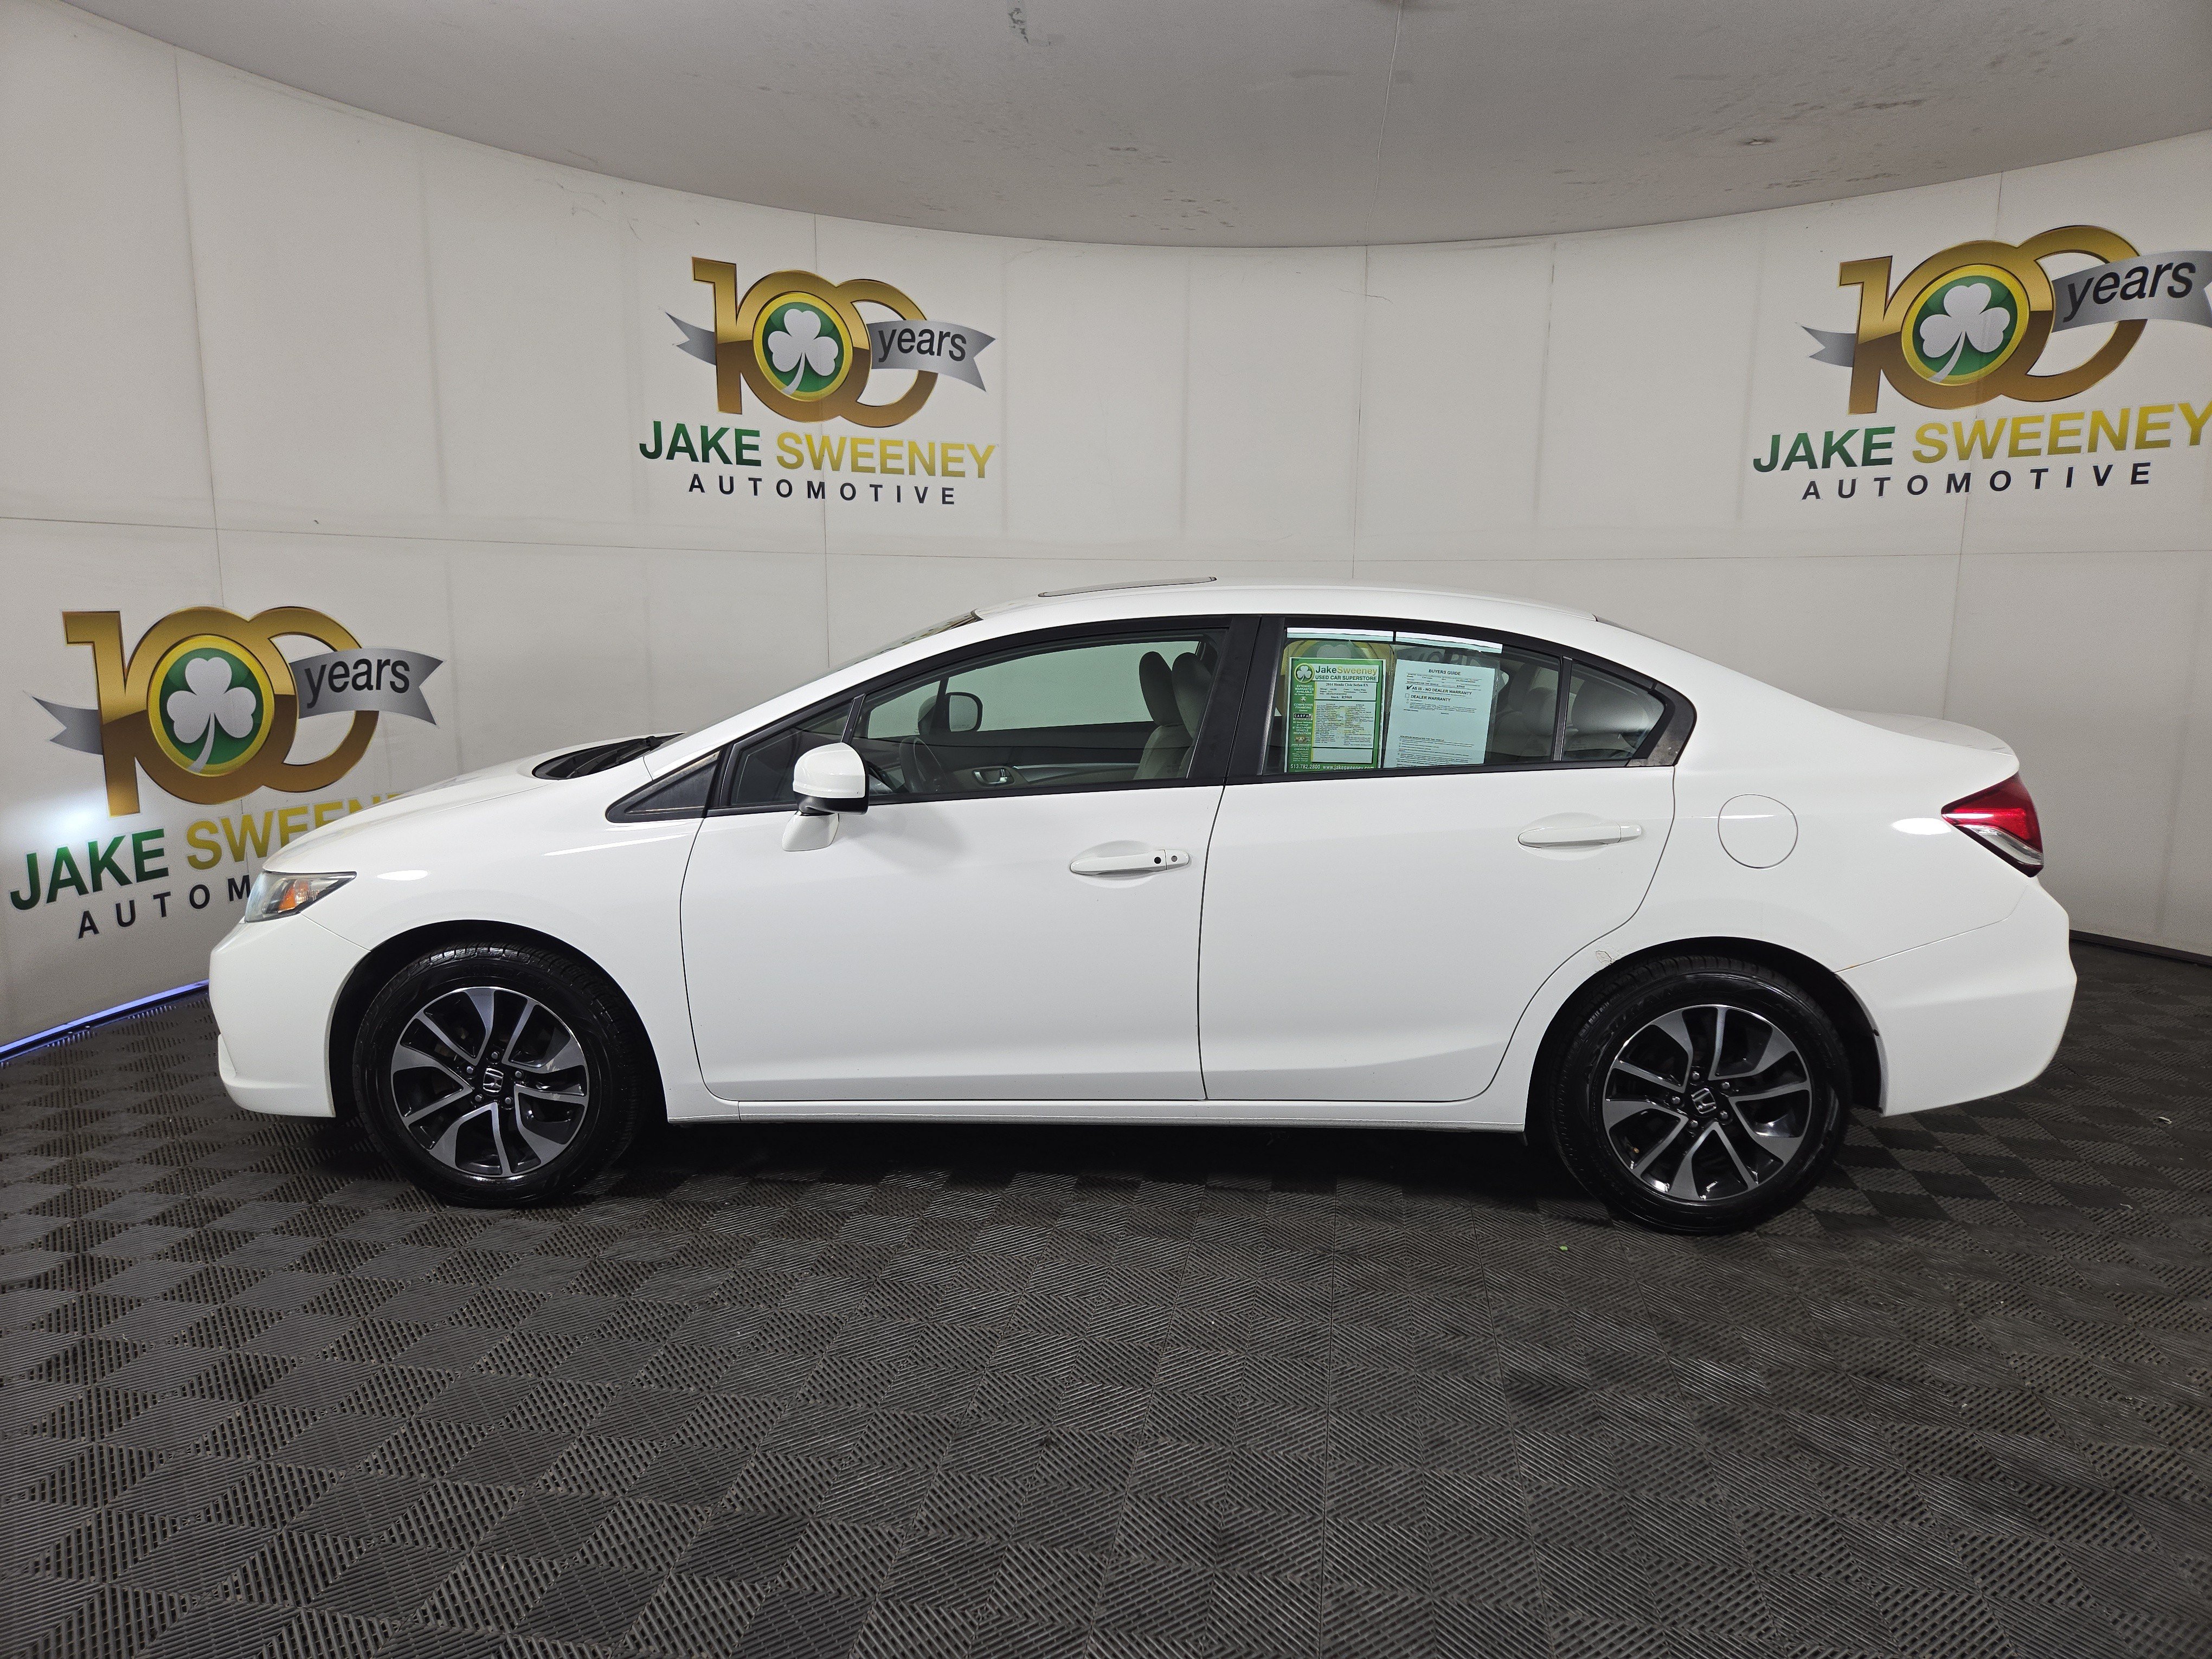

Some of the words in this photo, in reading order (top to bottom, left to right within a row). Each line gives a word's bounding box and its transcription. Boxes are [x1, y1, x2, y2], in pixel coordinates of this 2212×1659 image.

[2063, 261, 2196, 321] years
[878, 327, 967, 362] years
[639, 420, 762, 467] JAKE
[776, 430, 996, 478] SWEENEY
[1753, 426, 1896, 473] JAKE
[1912, 401, 2212, 464] SWEENEY
[689, 473, 955, 505] AUTOMOTIVE
[1801, 462, 2151, 500] AUTOMOTIVE
[305, 658, 410, 709] years
[10, 828, 169, 910] JAKE
[78, 877, 250, 940] AUTOM
